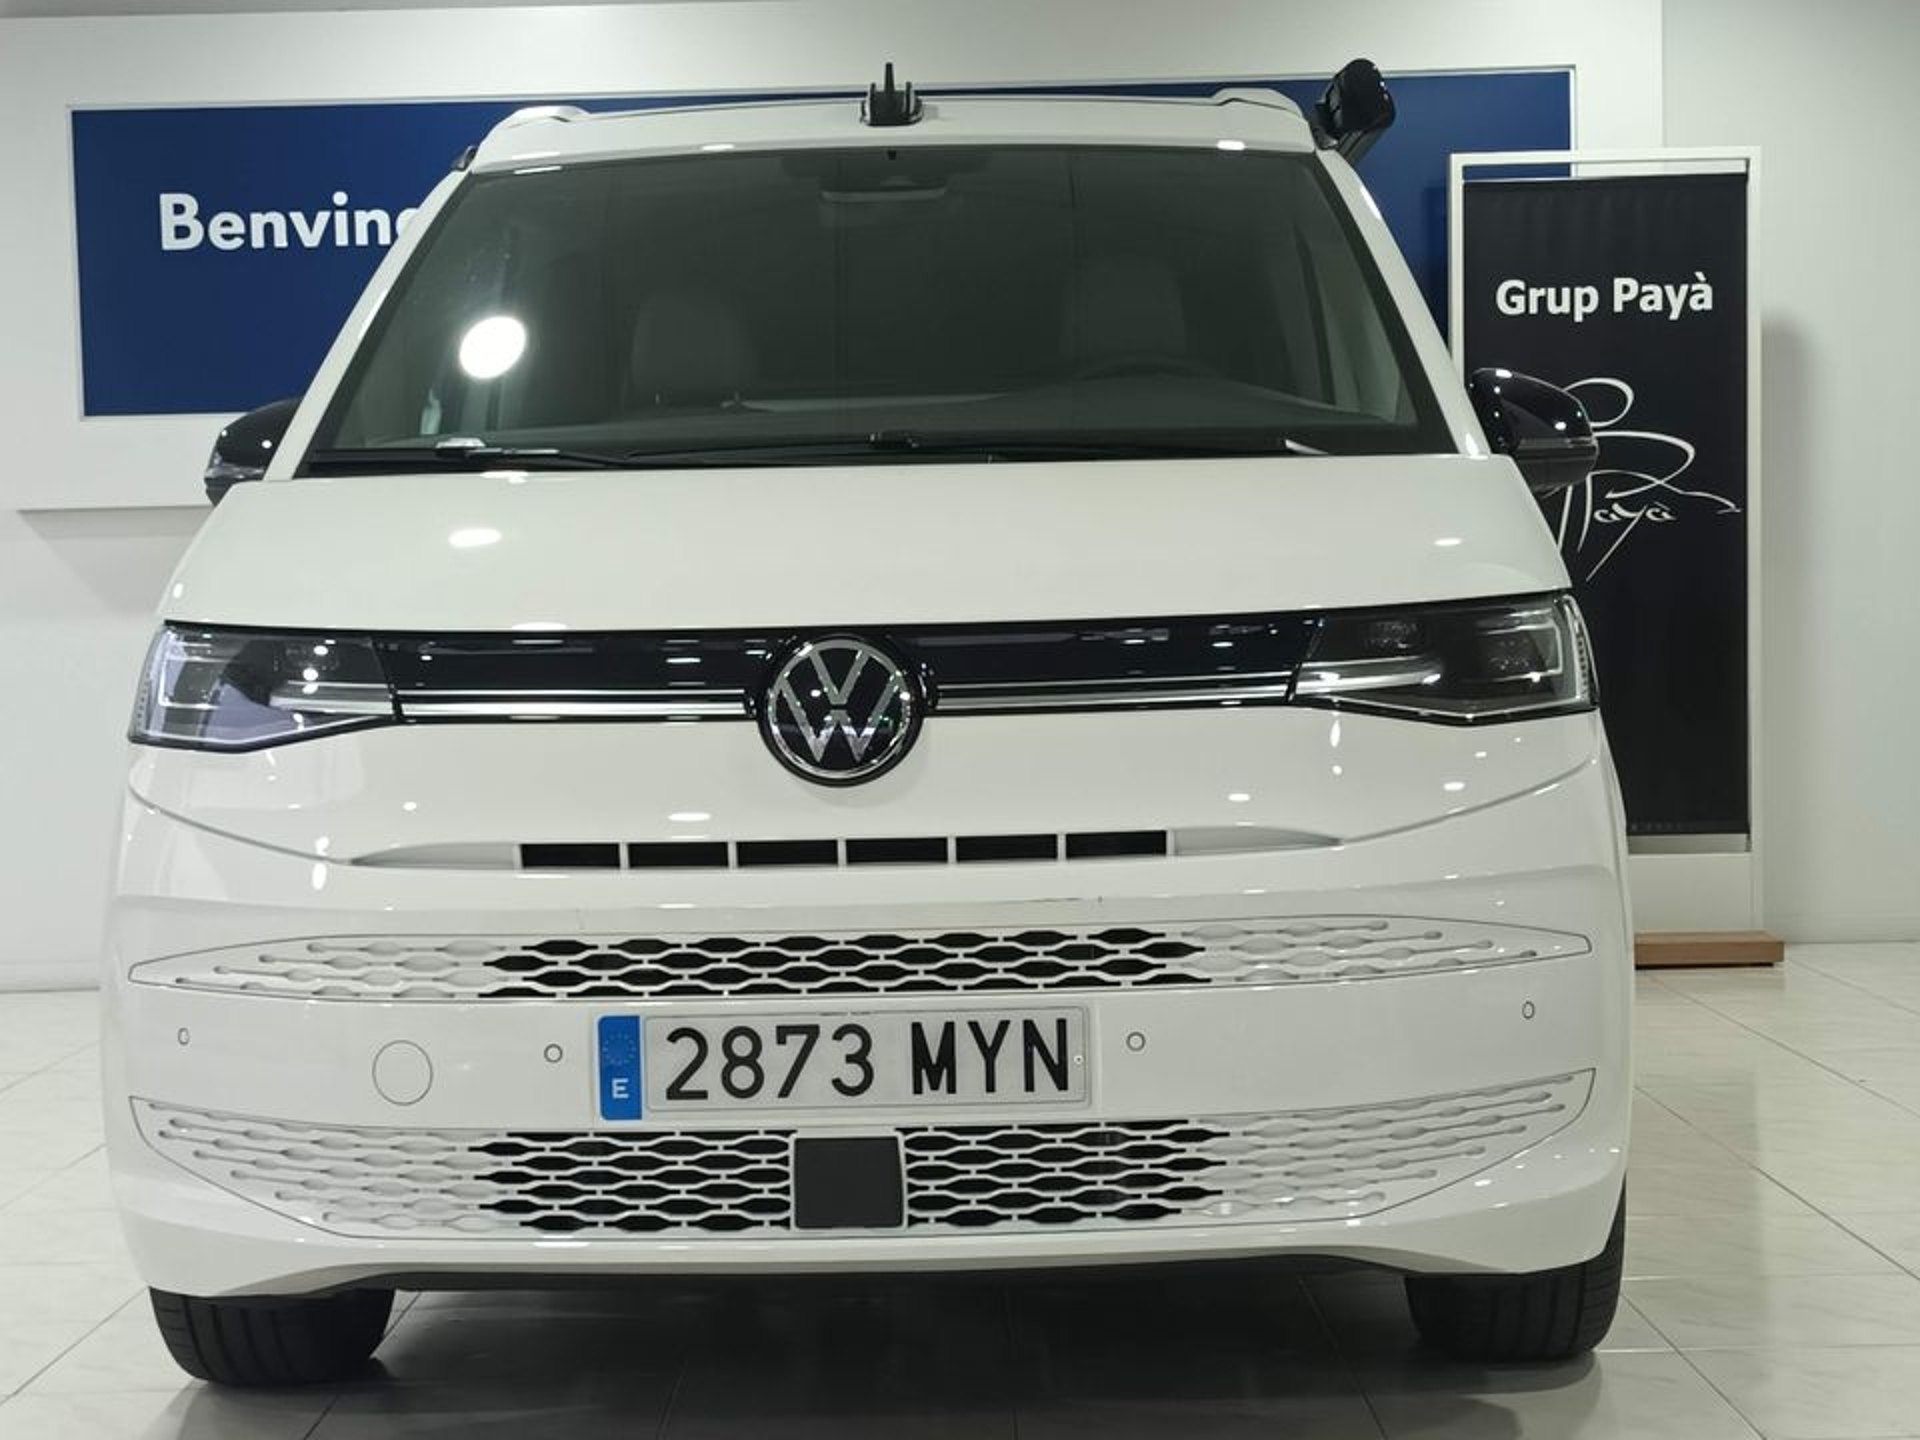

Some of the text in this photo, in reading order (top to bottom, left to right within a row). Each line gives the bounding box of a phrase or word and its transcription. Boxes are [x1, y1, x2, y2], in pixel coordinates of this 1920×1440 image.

[1495, 271, 1714, 323] Grup Payà
[665, 1017, 1070, 1101] 2873 MYN
[611, 1077, 630, 1099] E
